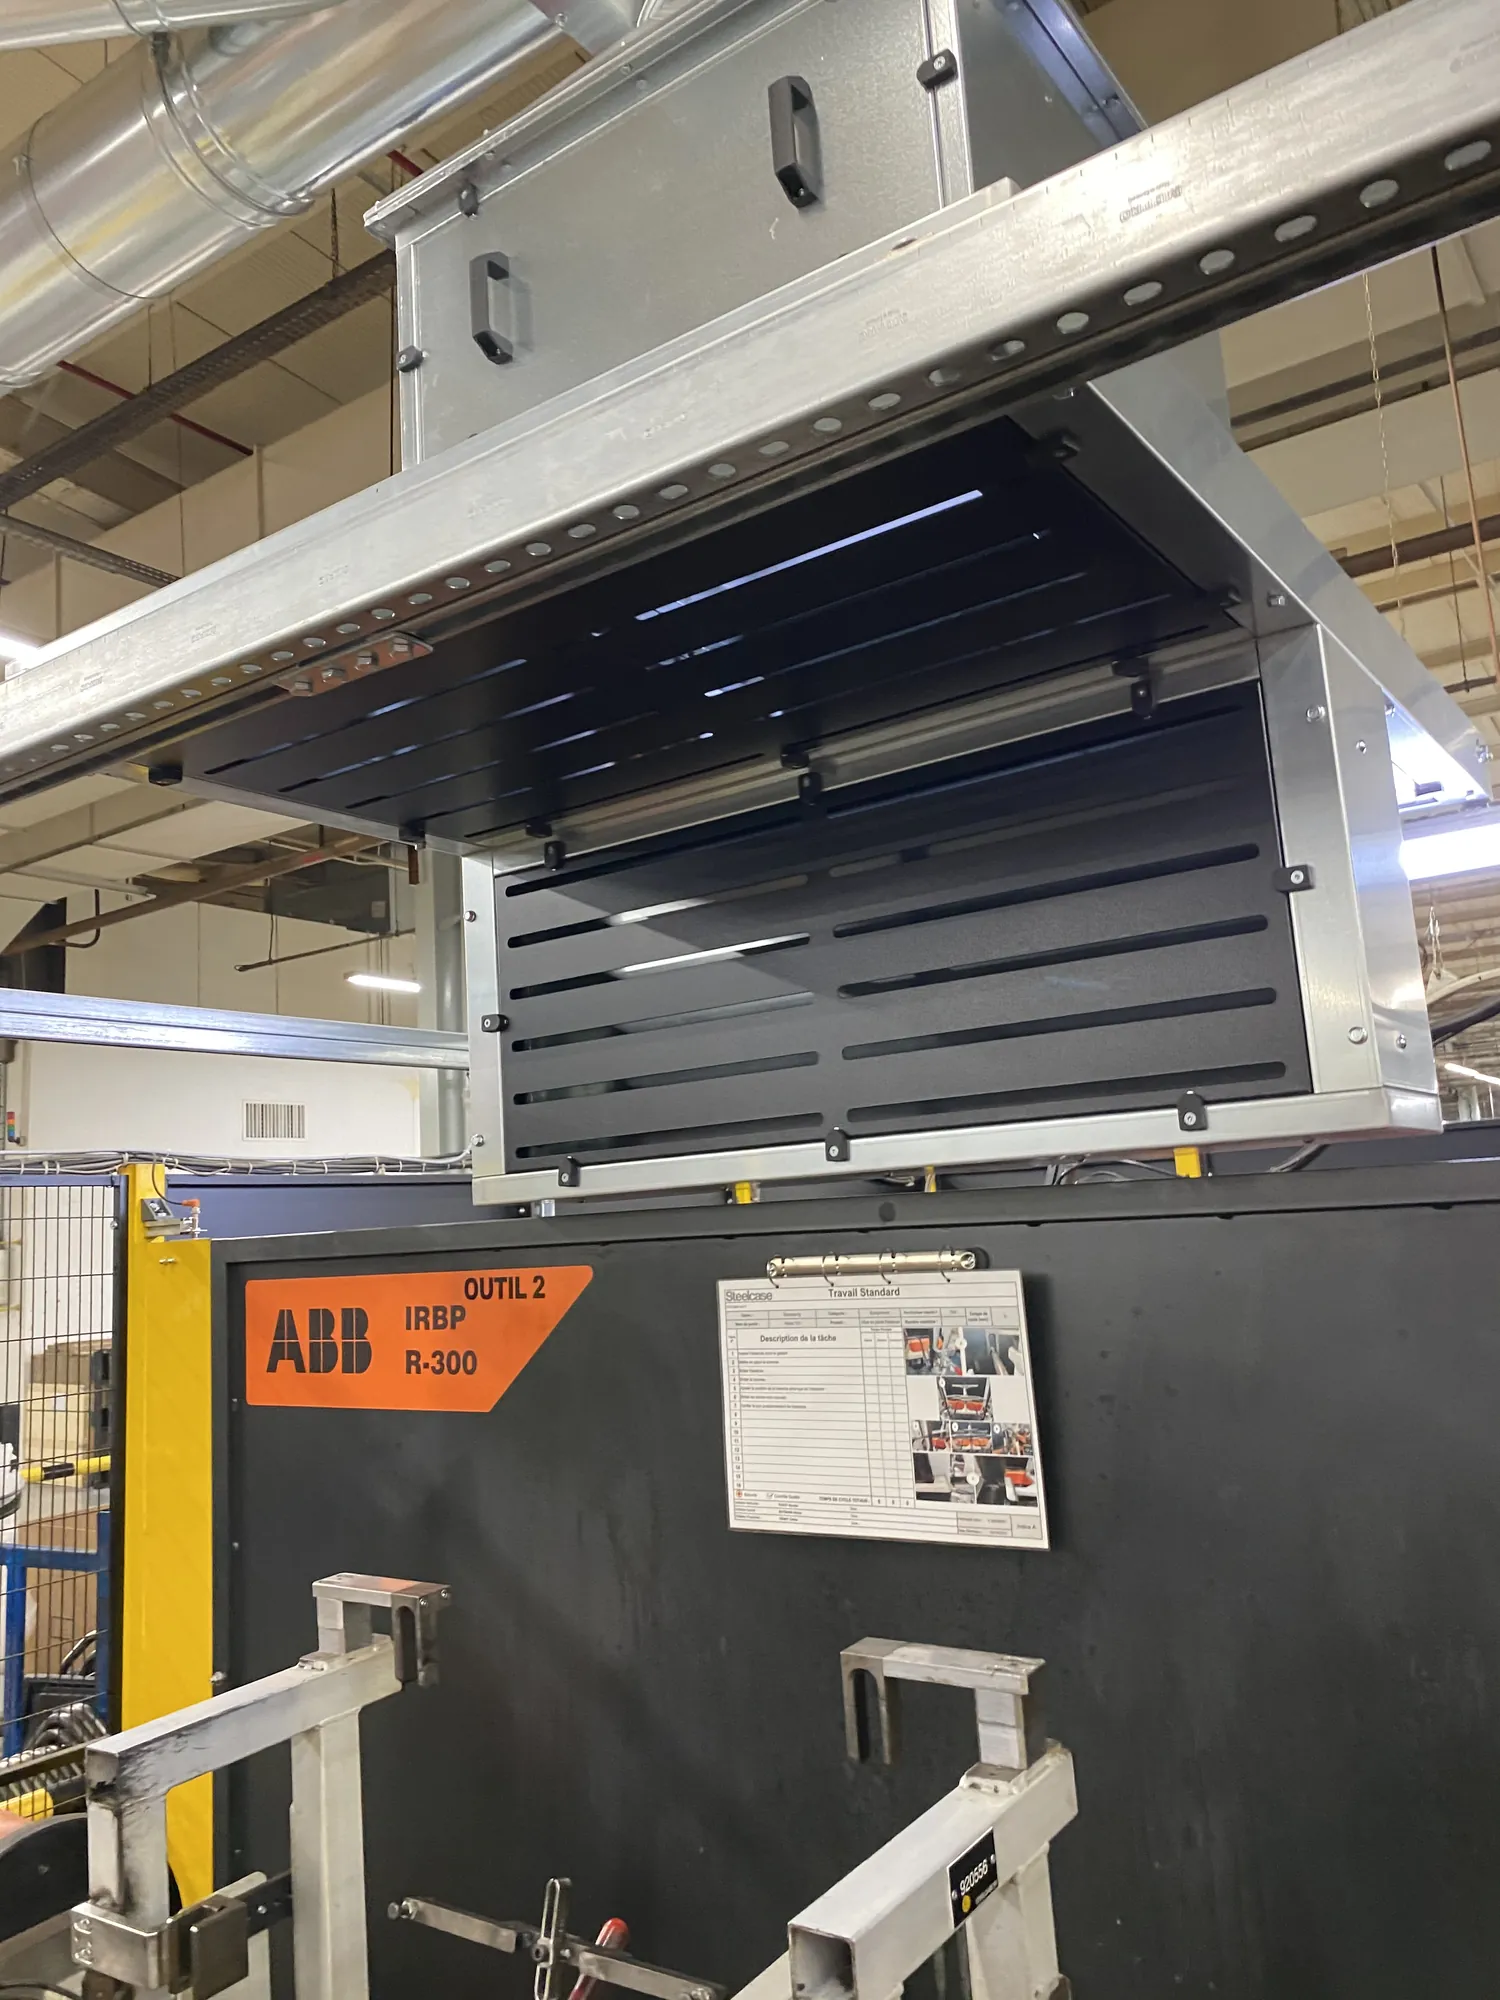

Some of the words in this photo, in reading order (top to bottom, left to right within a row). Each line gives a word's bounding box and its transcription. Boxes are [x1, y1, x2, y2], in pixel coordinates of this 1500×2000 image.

[464, 1277, 527, 1300] OUTIL
[532, 1275, 546, 1299] 2
[725, 1290, 773, 1302] Steelcase
[828, 1288, 858, 1298] Travail
[860, 1287, 900, 1297] Standard
[405, 1306, 467, 1331] IRBP
[266, 1307, 373, 1374] ABB
[760, 1334, 798, 1343] Description
[405, 1350, 478, 1375] R-300
[960, 1859, 988, 1895] 920556
